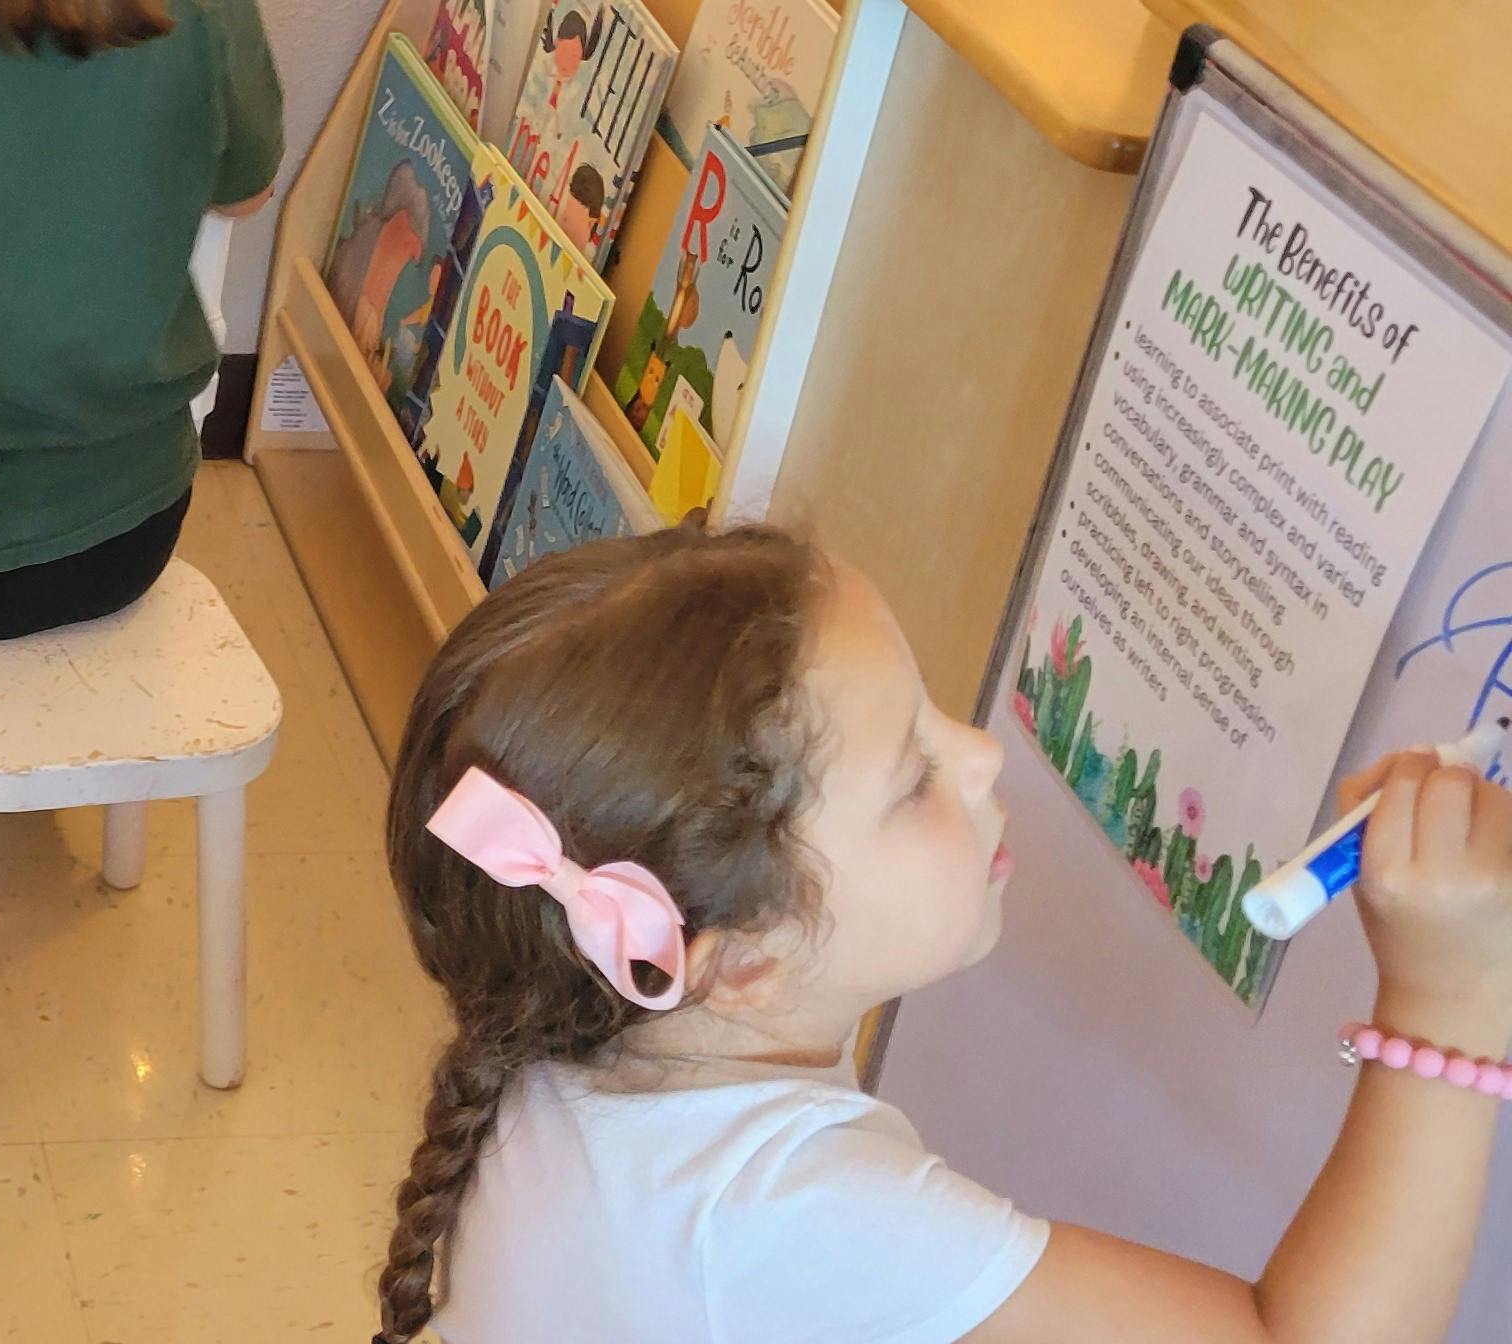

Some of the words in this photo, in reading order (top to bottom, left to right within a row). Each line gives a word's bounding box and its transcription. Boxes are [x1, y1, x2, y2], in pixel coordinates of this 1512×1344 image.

[377, 87, 395, 127] Z
[580, 4, 655, 168] TELL
[681, 150, 727, 264] R
[1236, 185, 1284, 254] The
[1277, 222, 1384, 339] Benefits
[1382, 323, 1420, 365] of
[466, 353, 506, 419] WITHOUT
[472, 284, 528, 392] BOOK
[1161, 269, 1336, 454] MARK-MAKING
[1328, 425, 1405, 514] PLAY
[1222, 253, 1334, 374] WRITING
[1326, 355, 1386, 416] and
[1104, 422, 1184, 514] conversations
[1183, 509, 1212, 541] and
[1209, 535, 1286, 626] storytelling
[1123, 360, 1156, 404] using
[1155, 388, 1229, 476] increasingly
[1229, 469, 1288, 532] complex
[1287, 526, 1318, 560] and
[1317, 554, 1366, 608] varied
[1134, 324, 1184, 390] learning
[1183, 376, 1198, 399] to
[1198, 393, 1260, 460] associate
[1257, 453, 1296, 495] print
[1296, 487, 1328, 525] with
[1328, 518, 1387, 587] reading
[1094, 452, 1183, 559] communicating
[1183, 549, 1206, 577] our
[1204, 568, 1240, 616] ideas
[1240, 609, 1294, 675] through
[1178, 463, 1239, 526] grammar
[1238, 522, 1267, 556] and
[1265, 550, 1313, 604] syntax
[1312, 592, 1328, 620] in
[1061, 569, 1113, 635] ourselves
[1112, 631, 1127, 652] as
[1127, 647, 1168, 701] writers
[1070, 540, 1131, 620] developing
[1130, 611, 1146, 634] an
[1145, 624, 1193, 690] internal
[1192, 684, 1229, 732] sense
[1230, 728, 1248, 749] of
[1077, 511, 1134, 584] practicing
[1133, 569, 1155, 606] left
[1155, 597, 1169, 620] to
[1168, 616, 1200, 657] right
[1198, 651, 1275, 742] progression
[1190, 599, 1218, 633] and
[1216, 627, 1263, 689] writing
